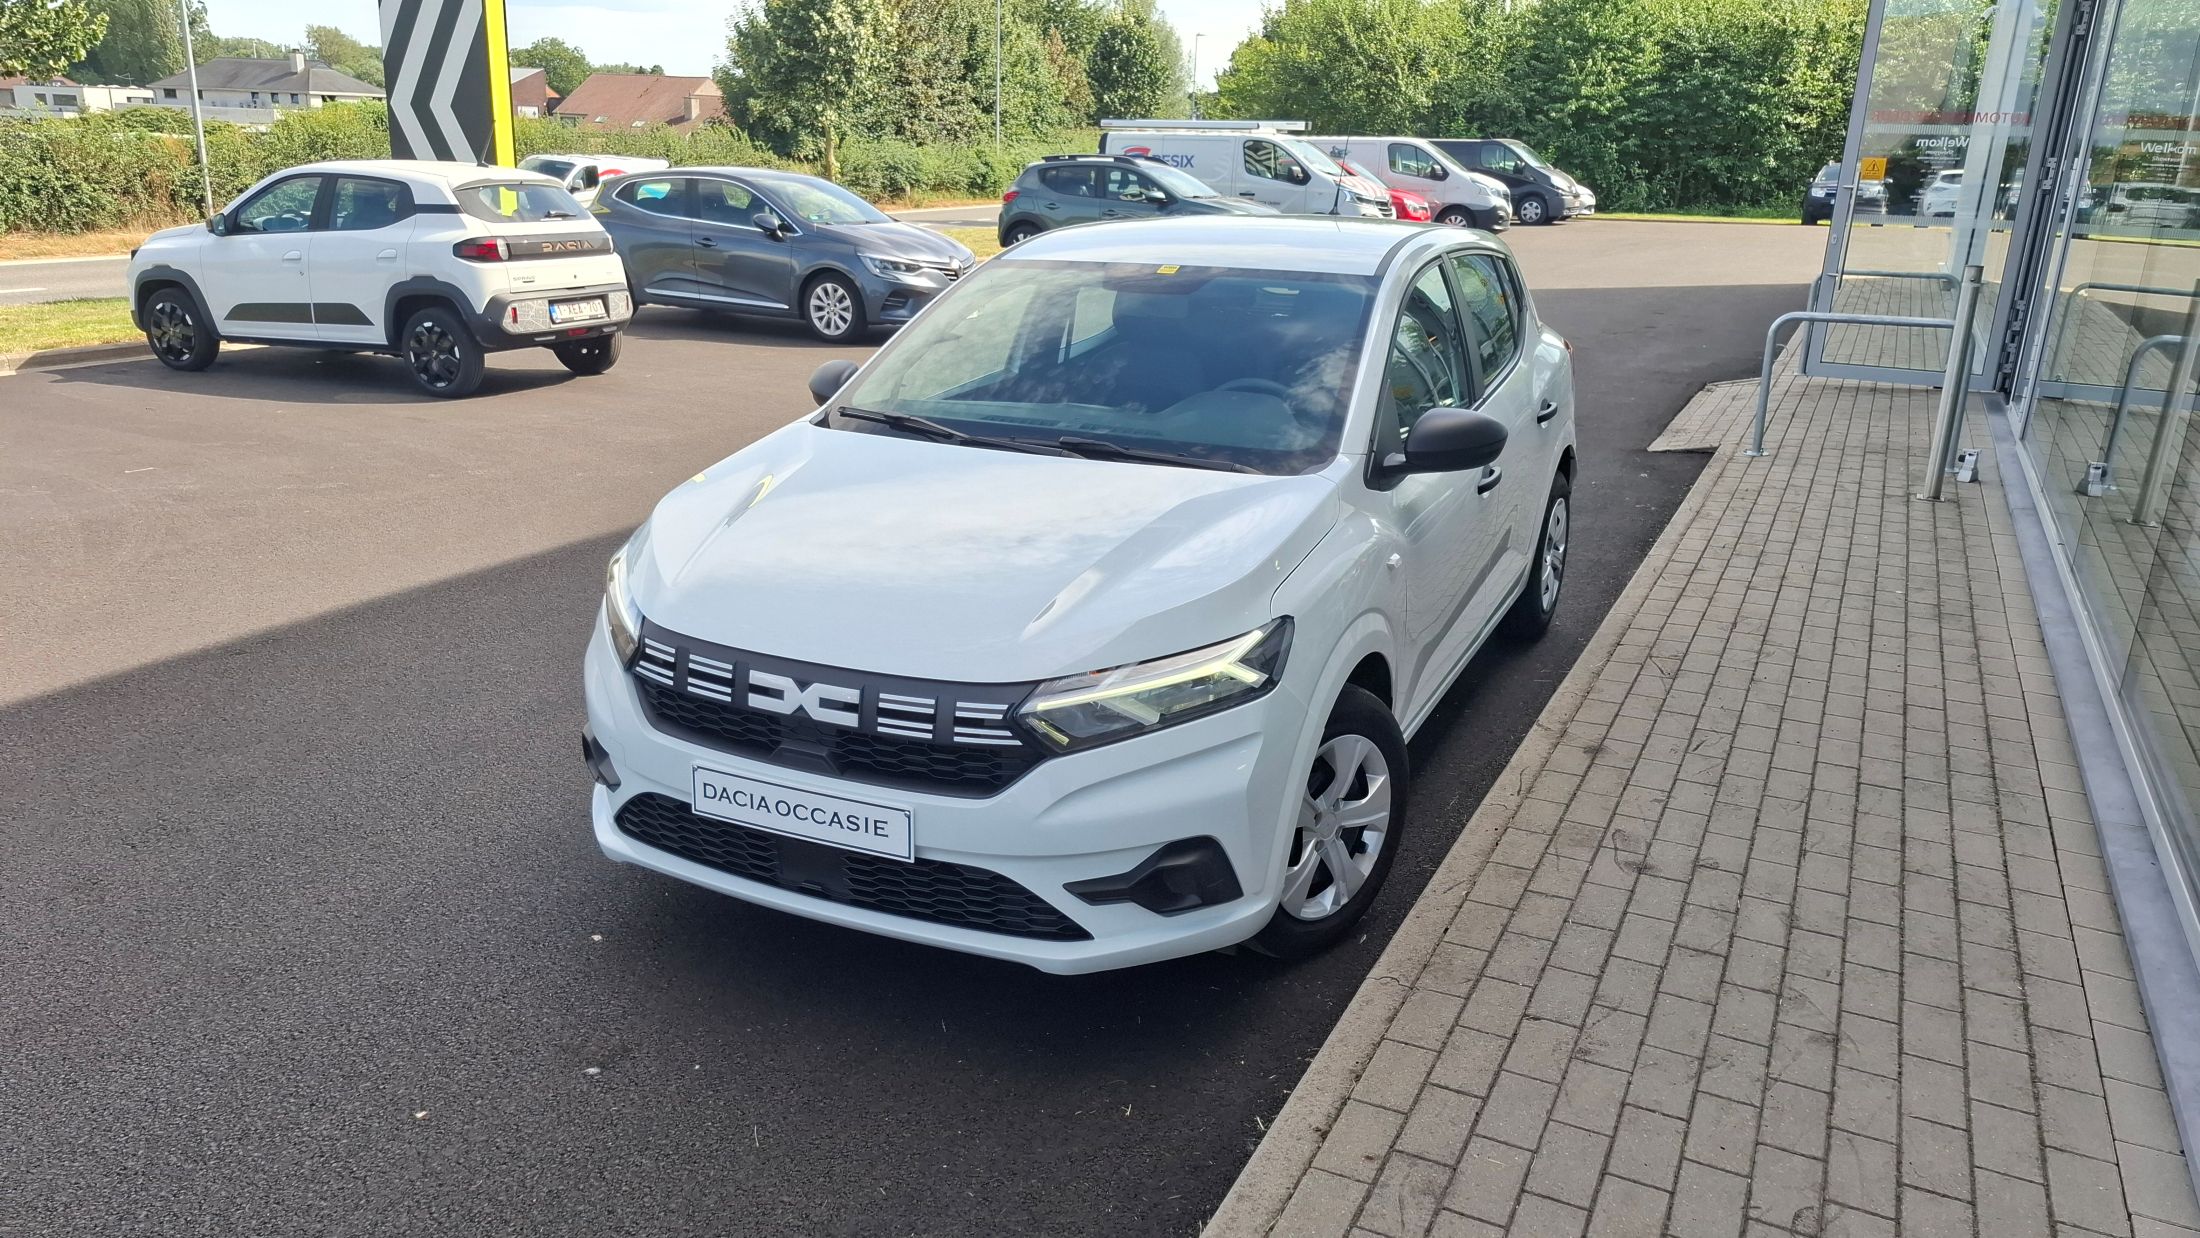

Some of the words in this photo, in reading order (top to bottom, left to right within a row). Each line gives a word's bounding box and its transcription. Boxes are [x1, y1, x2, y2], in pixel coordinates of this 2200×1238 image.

[2140, 141, 2197, 155] Welkom
[542, 240, 594, 253] DACIA
[703, 782, 771, 814] DACIA
[775, 799, 889, 838] OCCASIE
